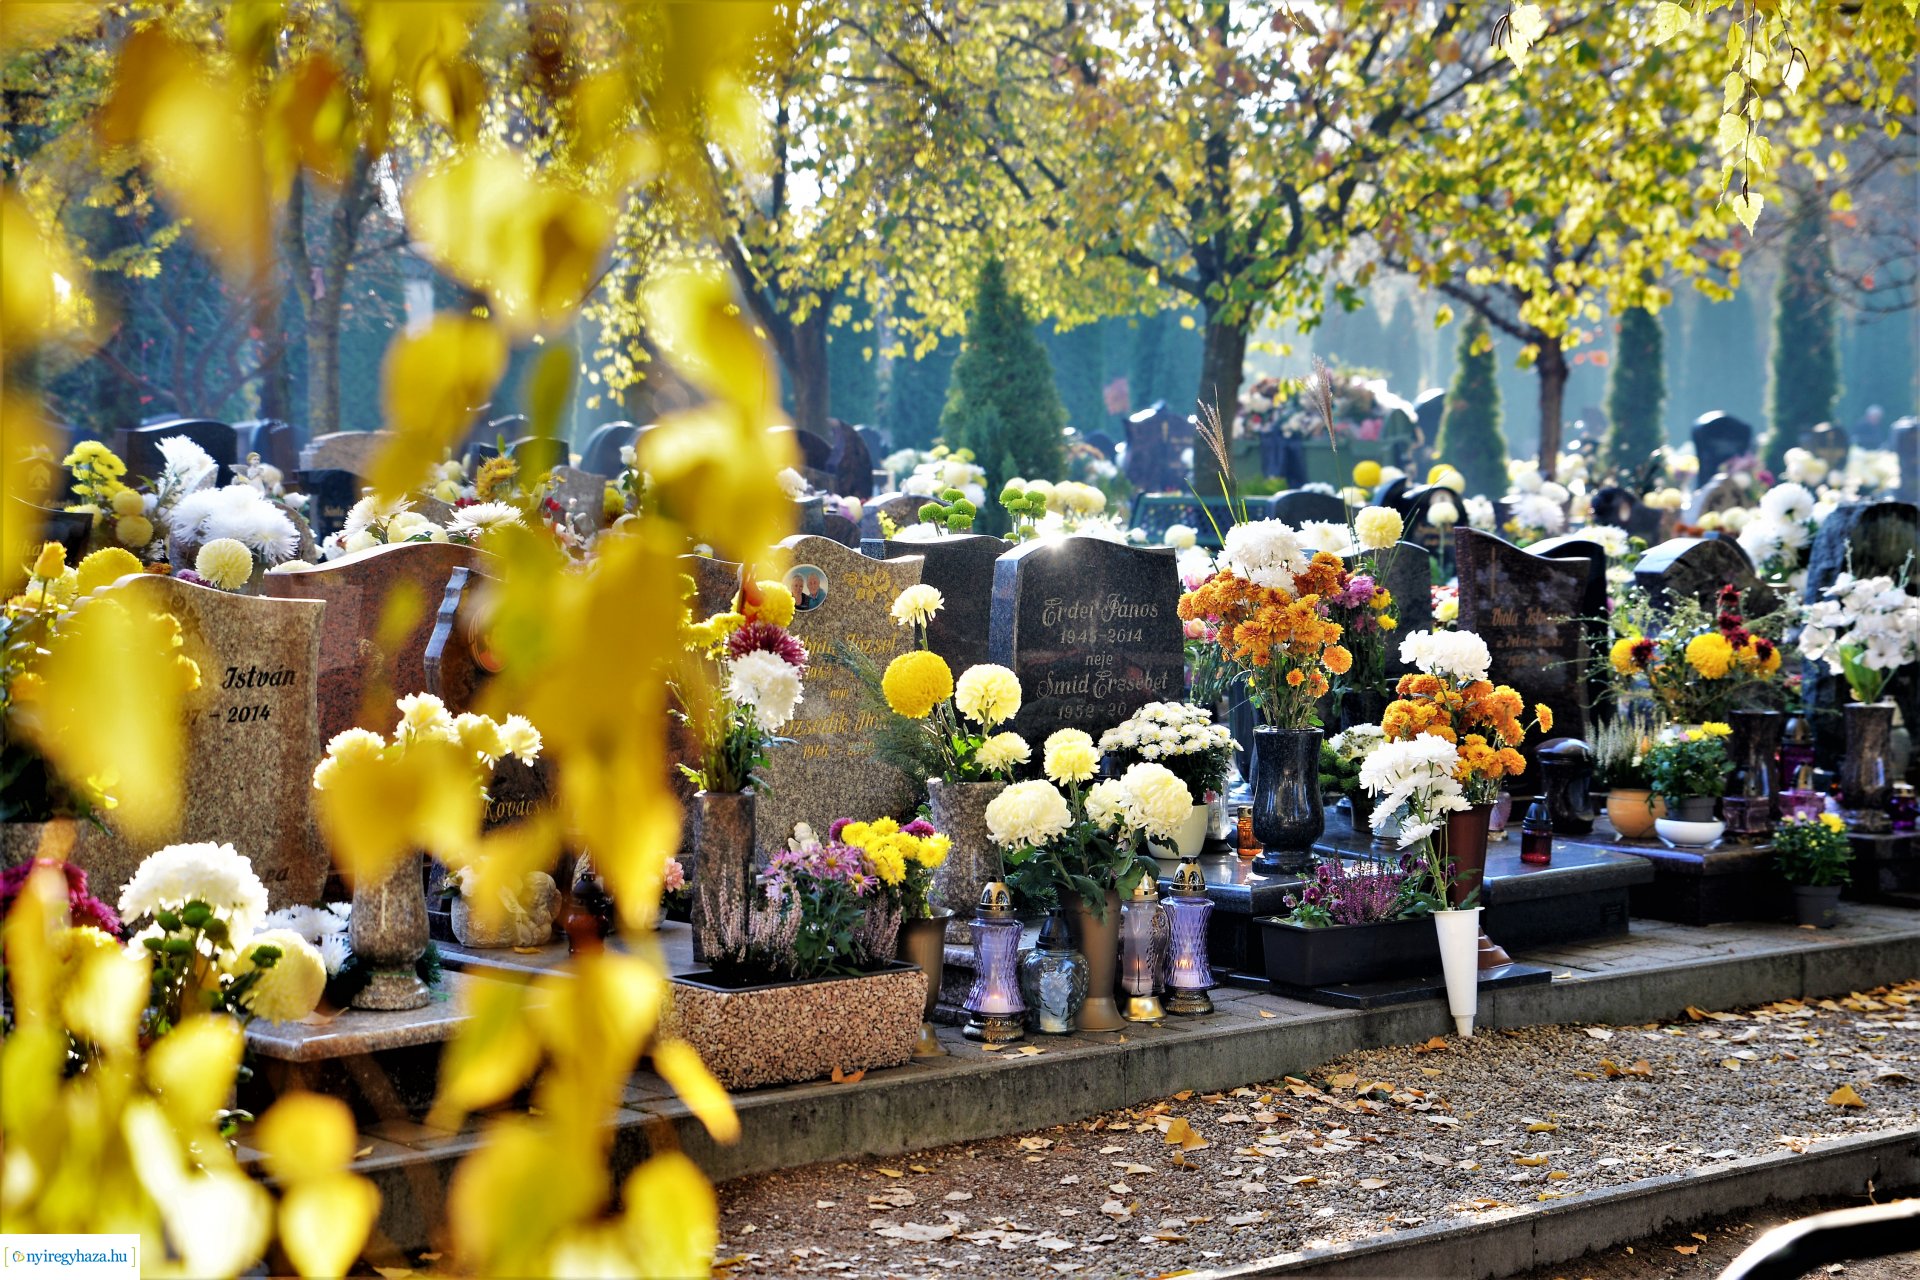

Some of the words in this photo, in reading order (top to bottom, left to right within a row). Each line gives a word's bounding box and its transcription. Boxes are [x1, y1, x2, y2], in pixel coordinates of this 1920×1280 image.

[1101, 593, 1159, 623] János
[1084, 650, 1114, 670] neje
[222, 664, 297, 690] István
[1036, 670, 1090, 700] Smid
[227, 704, 271, 723] 2014
[483, 792, 541, 823] Kovács
